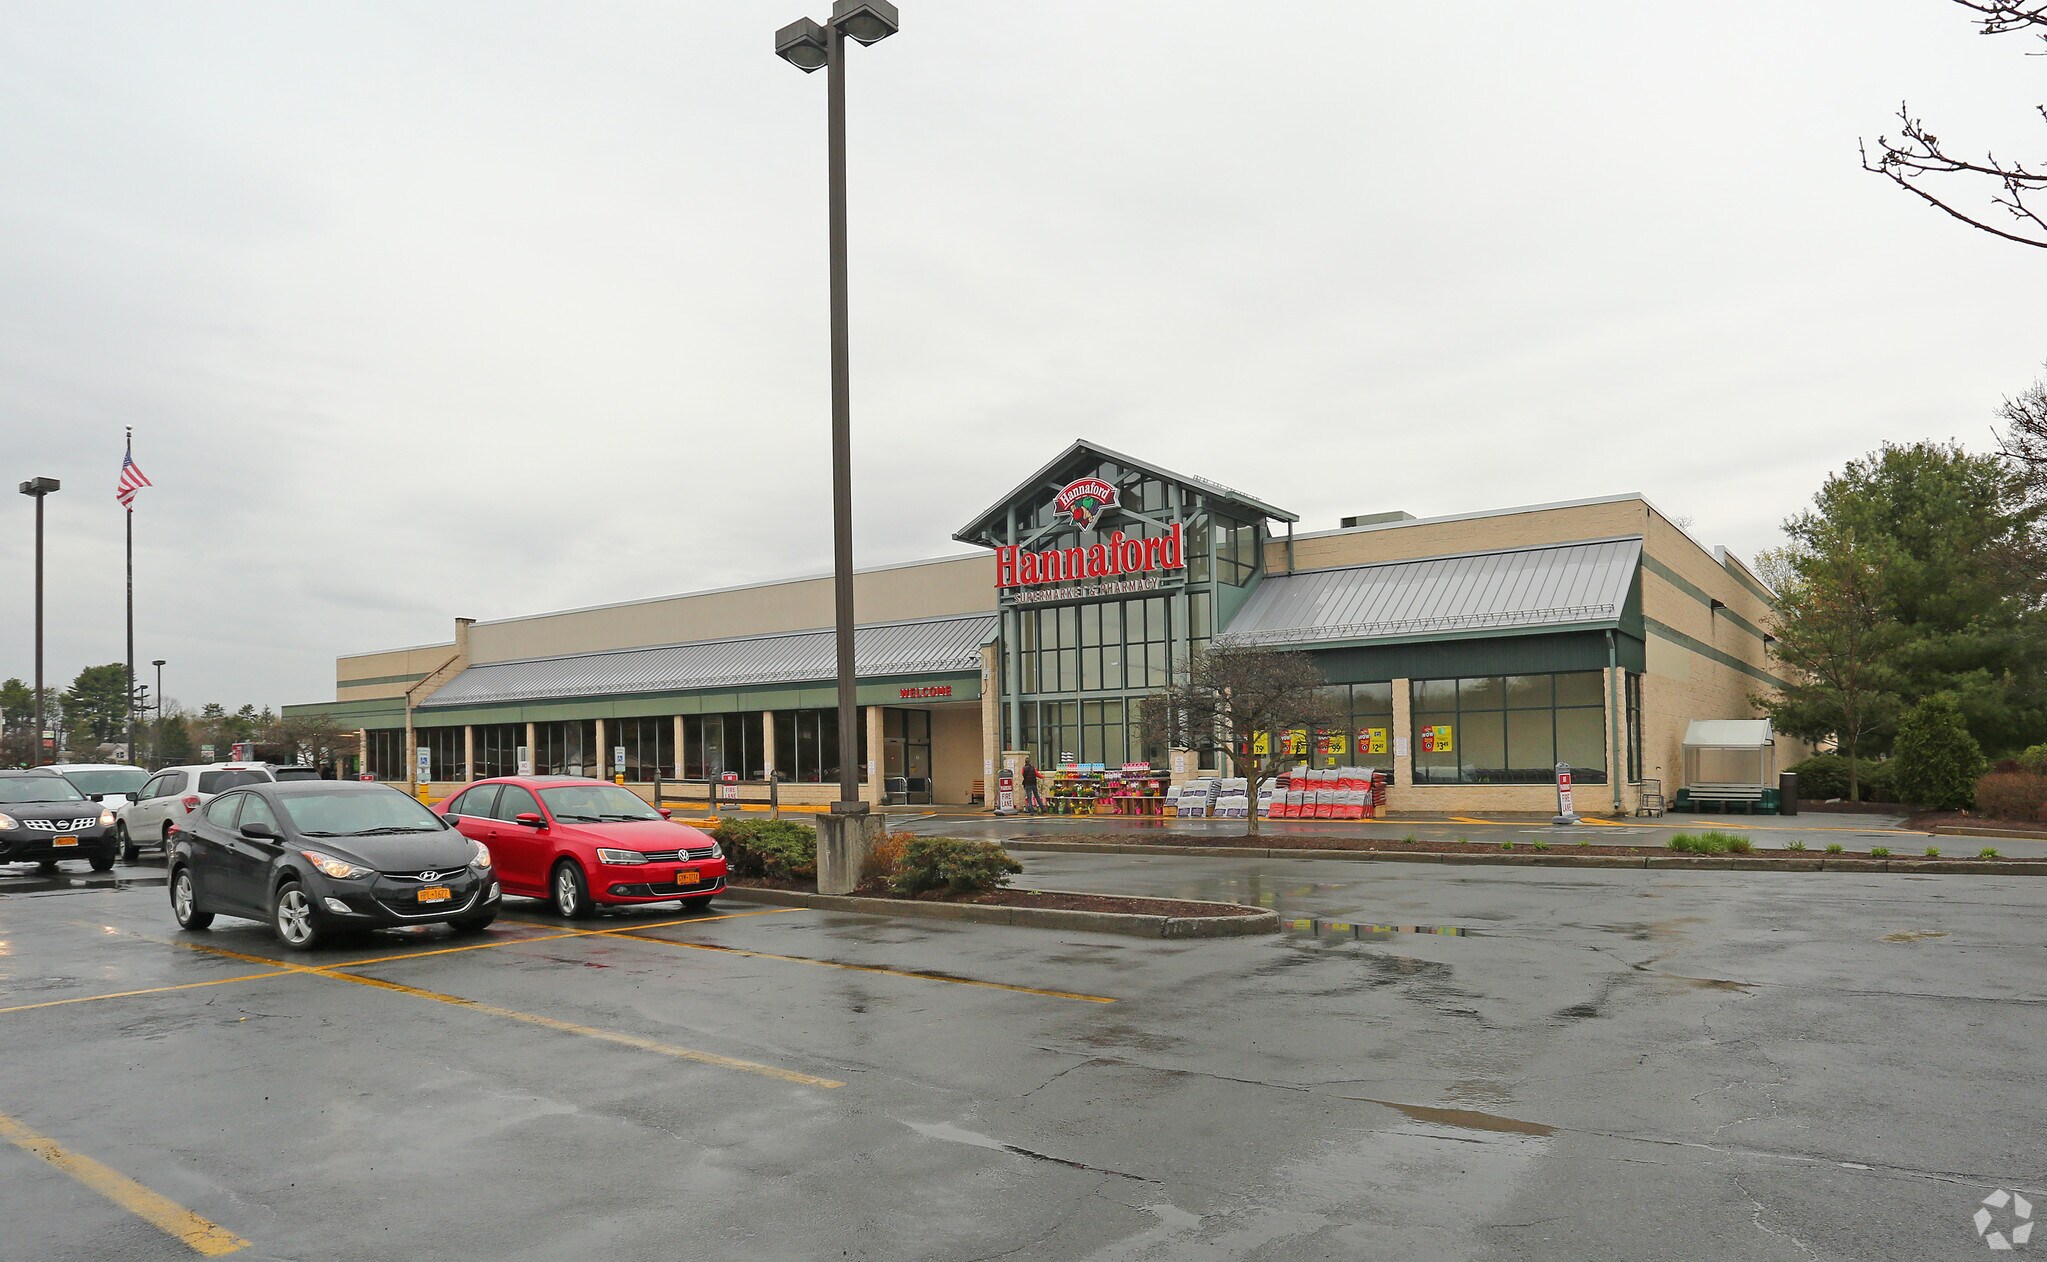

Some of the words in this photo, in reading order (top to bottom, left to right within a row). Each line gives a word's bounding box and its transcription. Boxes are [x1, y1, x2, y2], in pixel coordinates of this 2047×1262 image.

[1060, 482, 1110, 506] Hannaford
[994, 523, 1186, 588] Hannaford
[1014, 585, 1087, 604] SUPERMARKET
[1089, 584, 1096, 596] &
[1100, 577, 1159, 595] PHARMACY
[900, 685, 952, 698] WELCOME
[1562, 794, 1570, 802] FIRE
[1563, 803, 1572, 812] LANE
